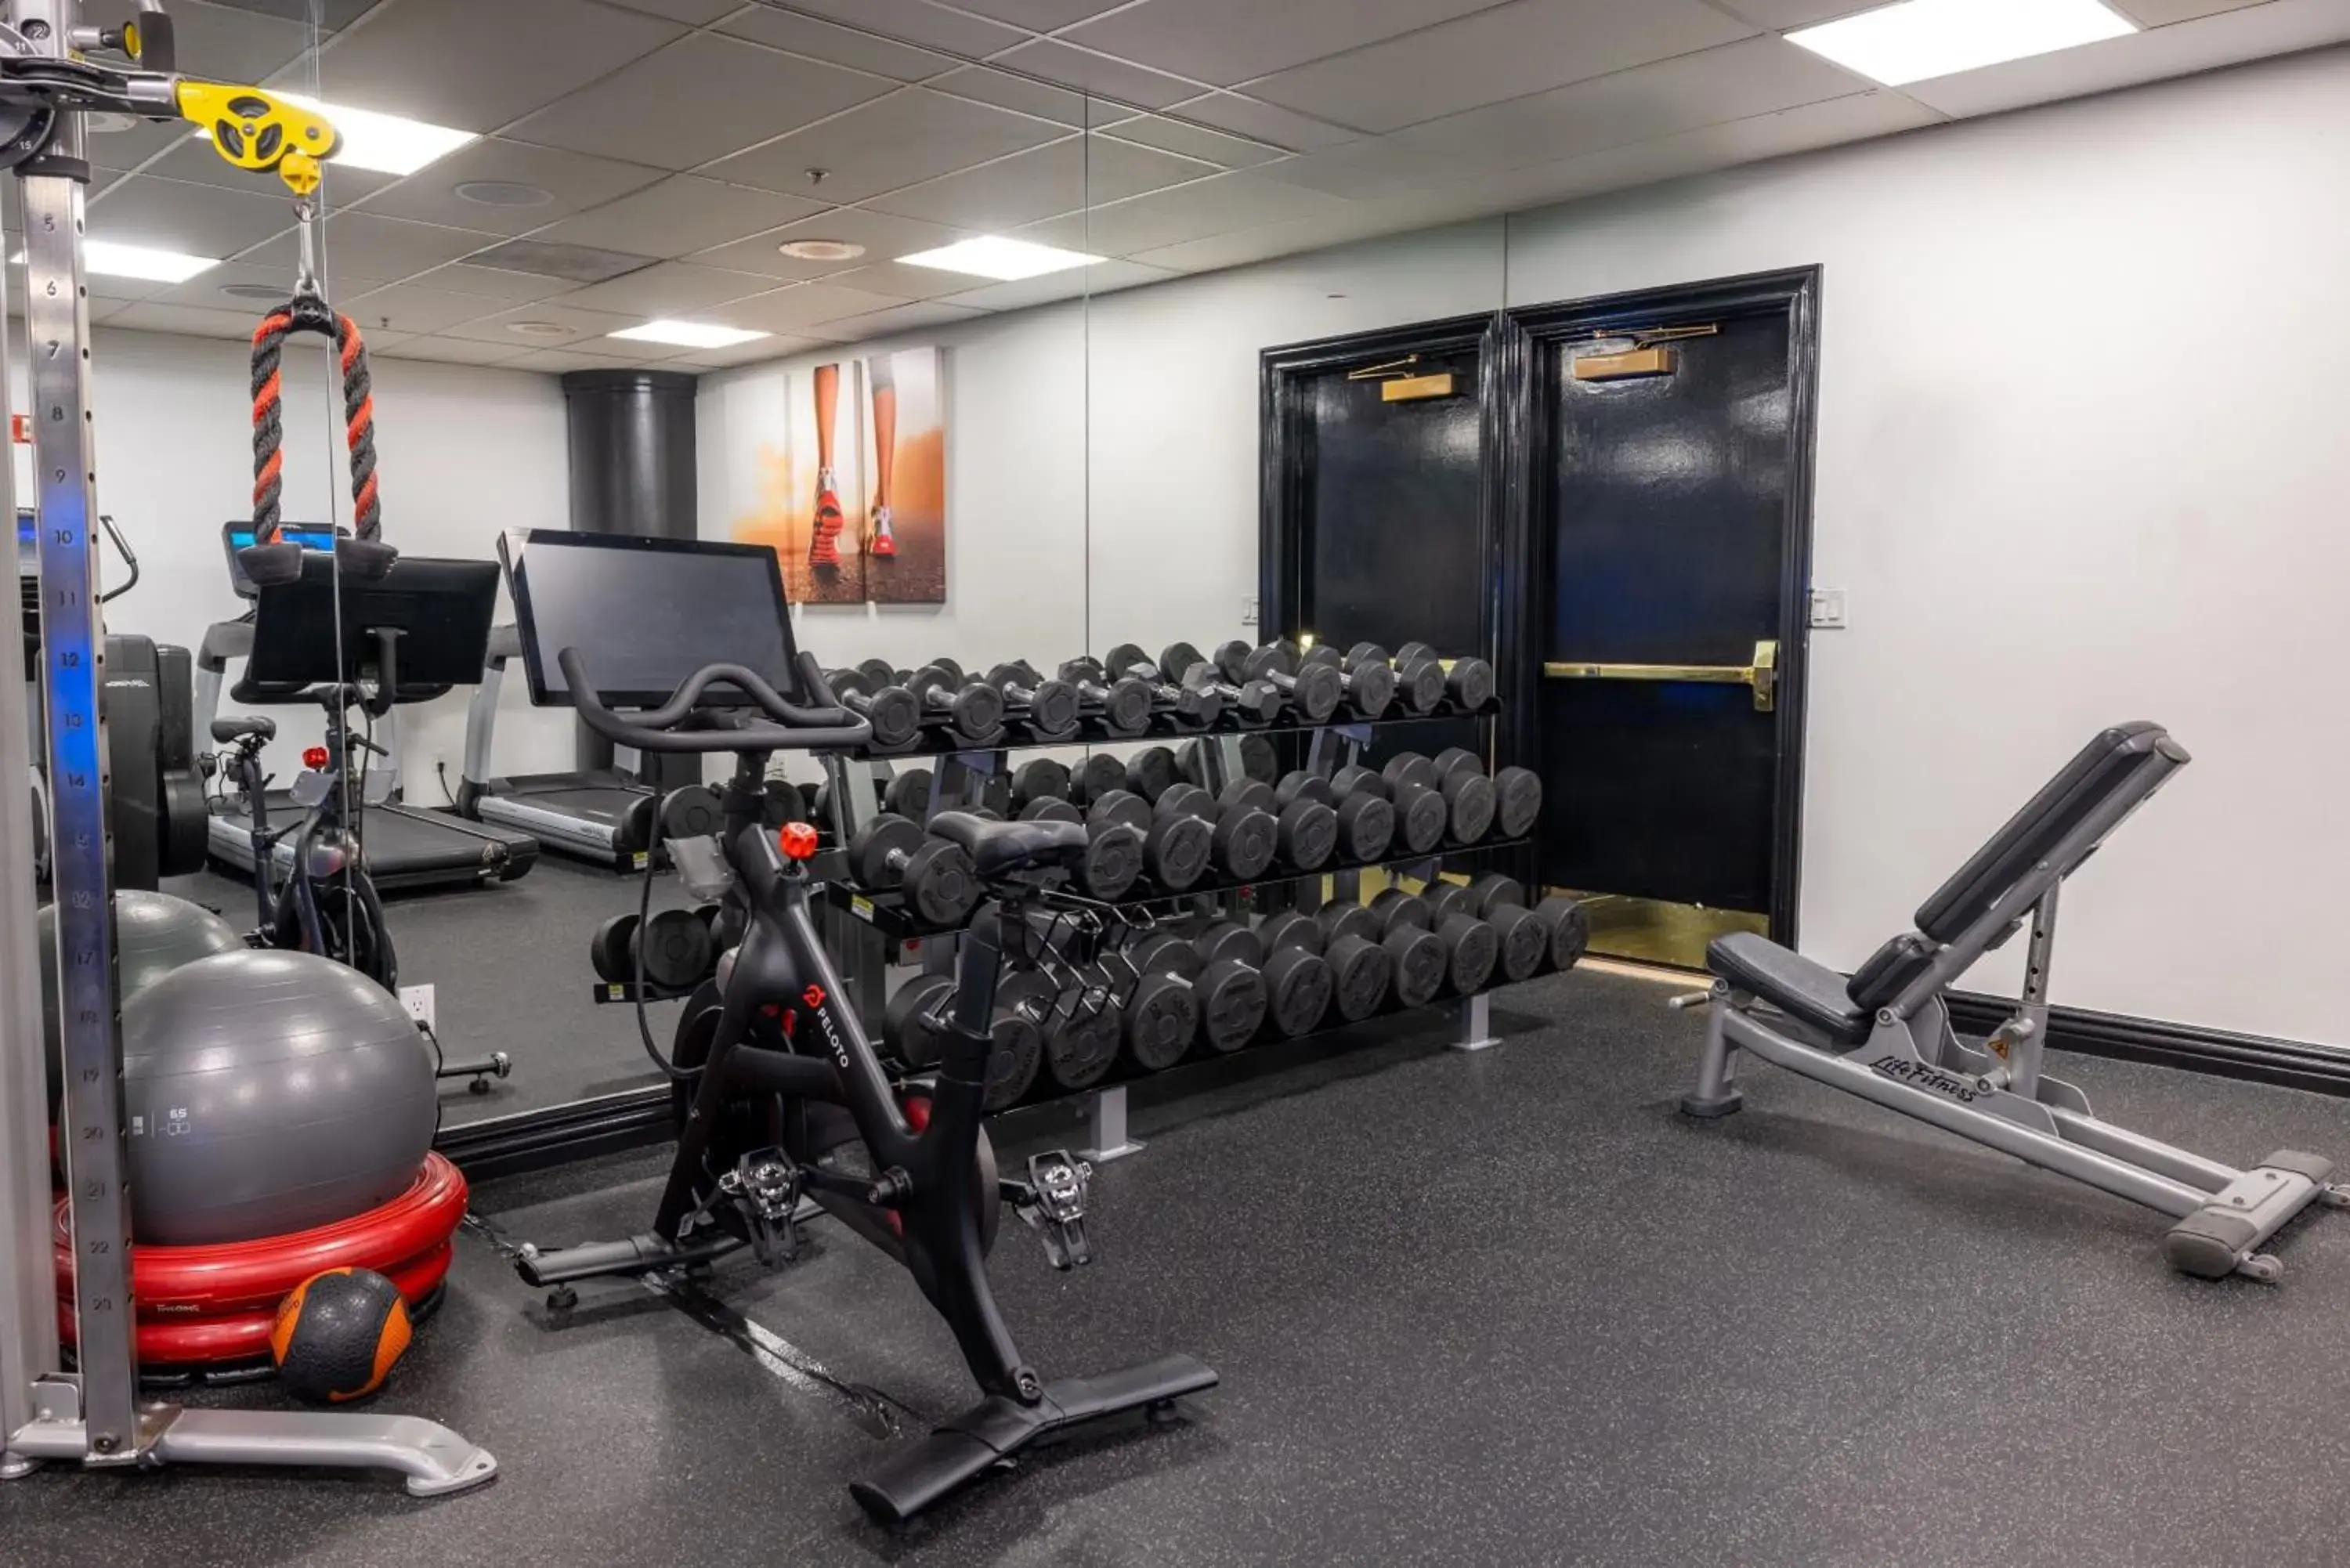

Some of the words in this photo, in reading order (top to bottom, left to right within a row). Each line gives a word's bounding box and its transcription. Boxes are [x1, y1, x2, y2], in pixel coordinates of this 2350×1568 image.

[20, 140, 32, 150] 15
[44, 214, 55, 233] 5
[46, 280, 56, 297] 6
[48, 339, 60, 359] 7
[52, 406, 63, 422] 8
[56, 469, 66, 484] 9
[54, 529, 73, 545] 10
[59, 591, 76, 608] 11
[60, 652, 78, 667] 12
[67, 772, 85, 788] 14
[87, 1180, 106, 1198] 21
[89, 1240, 110, 1254] 22
